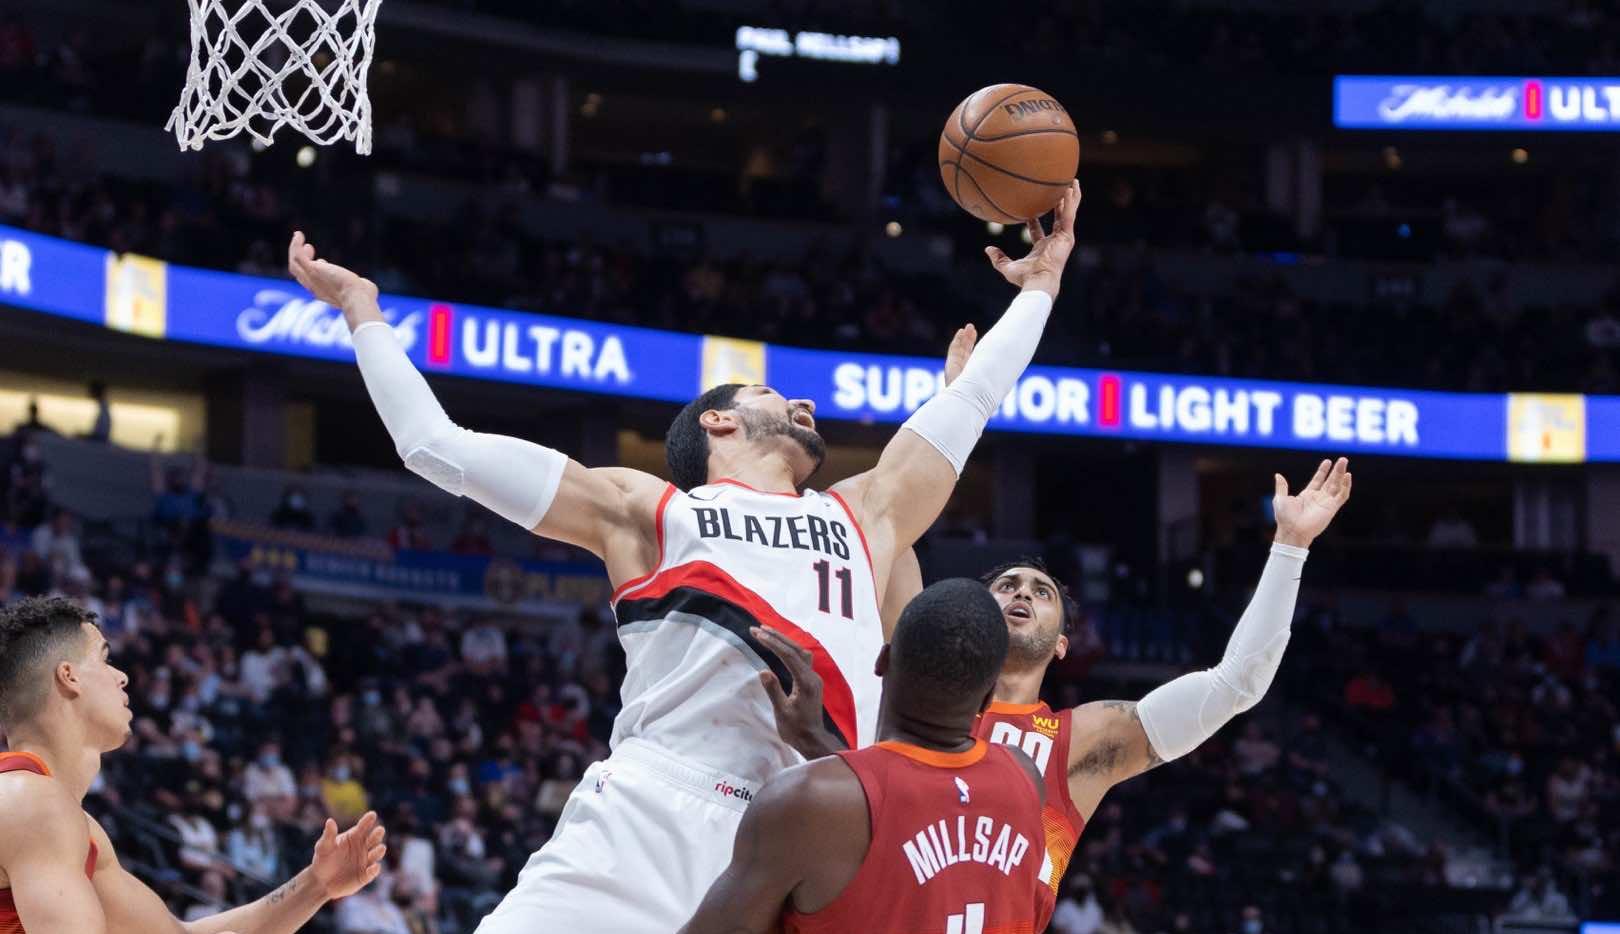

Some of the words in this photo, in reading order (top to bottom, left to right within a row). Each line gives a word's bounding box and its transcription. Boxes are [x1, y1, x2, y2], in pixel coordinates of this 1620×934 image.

[462, 317, 631, 384] ULTRA
[833, 362, 1089, 423] SUPIOR
[1130, 384, 1279, 436] LIGHT
[1293, 395, 1418, 446] BEER
[691, 507, 850, 561] BLAZERS
[813, 559, 853, 621] 11
[902, 815, 1029, 886] MILLSAP
